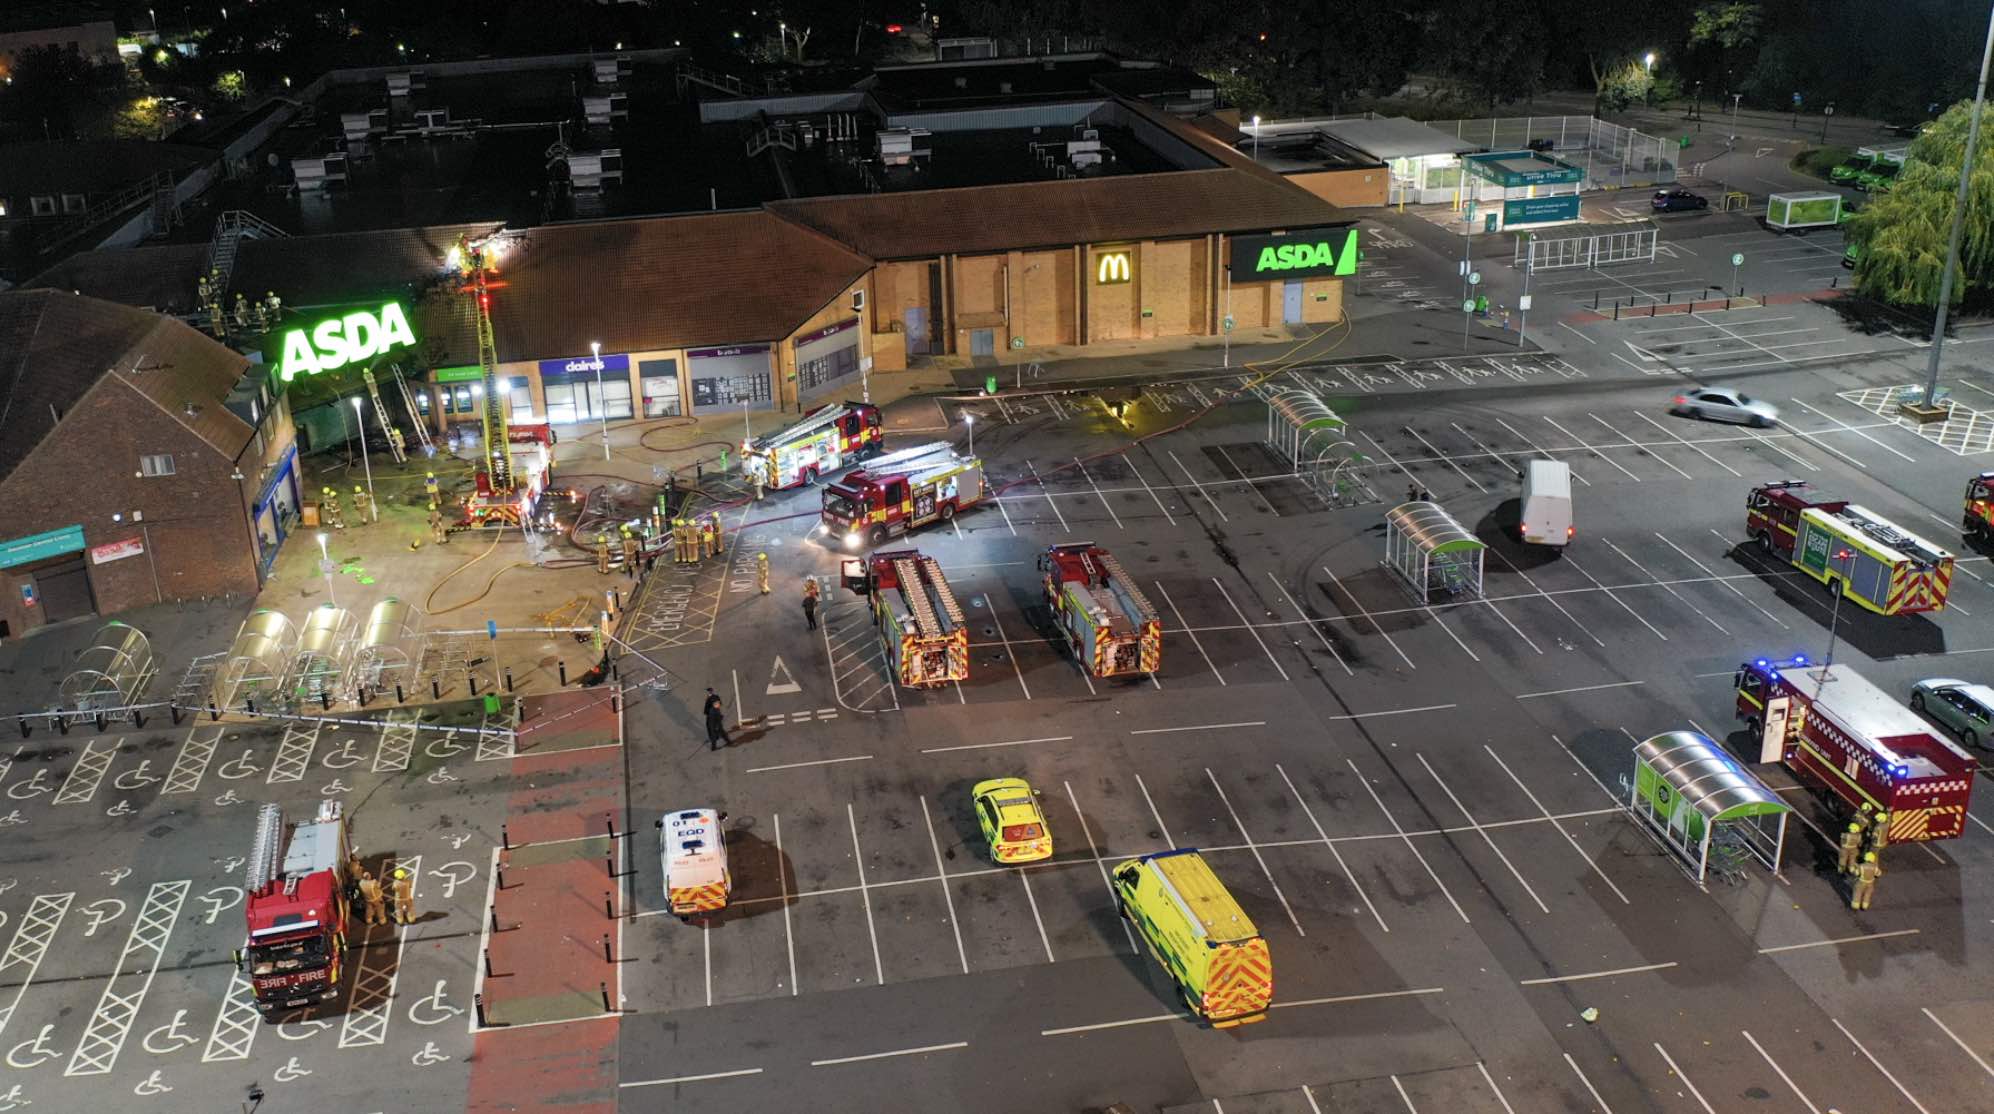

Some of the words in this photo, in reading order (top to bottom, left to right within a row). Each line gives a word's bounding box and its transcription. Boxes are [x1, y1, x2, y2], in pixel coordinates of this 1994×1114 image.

[1256, 242, 1334, 272] ASDA
[281, 302, 416, 382] ASDA
[299, 969, 327, 983] FIRE
